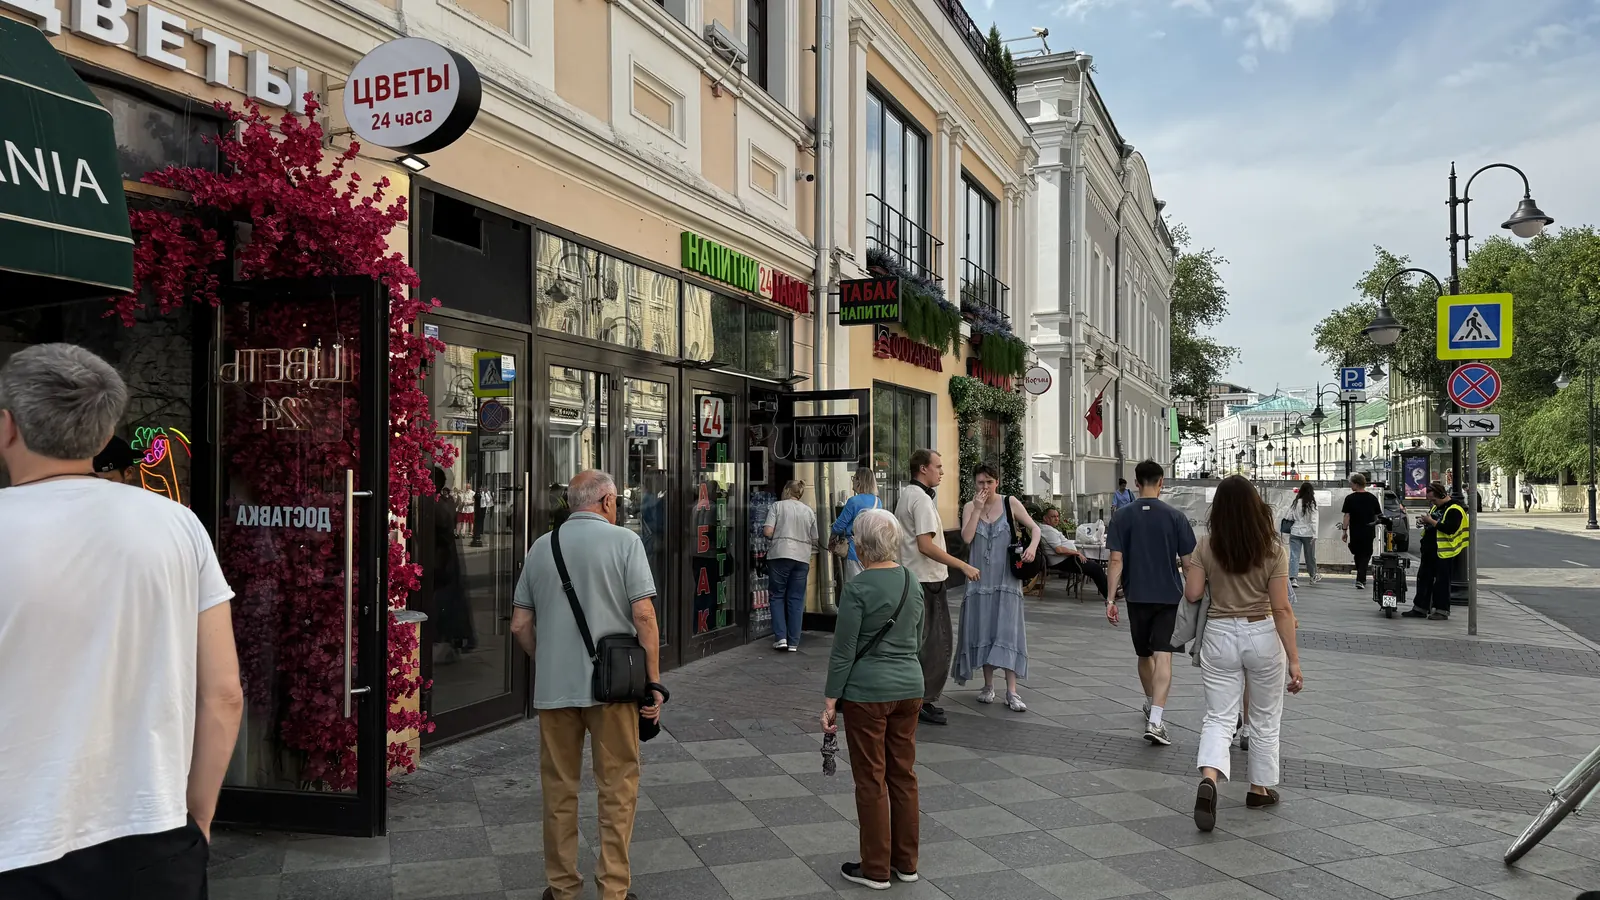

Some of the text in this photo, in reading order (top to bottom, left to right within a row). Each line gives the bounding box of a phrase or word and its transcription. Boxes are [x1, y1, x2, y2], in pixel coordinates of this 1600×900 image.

[353, 63, 449, 109] ЦВЕТЫ
[371, 109, 433, 131] 24 часа
[0, 139, 110, 205] NIA
[687, 232, 809, 314] НАПИТКИ 24 ТАБАК
[840, 280, 898, 303] ТАБАК
[840, 303, 898, 321] НАПИТКИ
[1345, 369, 1359, 388] P
[702, 398, 722, 435] 24
[796, 423, 852, 438] ТАБАК 24
[794, 442, 854, 456] НАПИТКИ
[697, 441, 711, 632] ТАБАК
